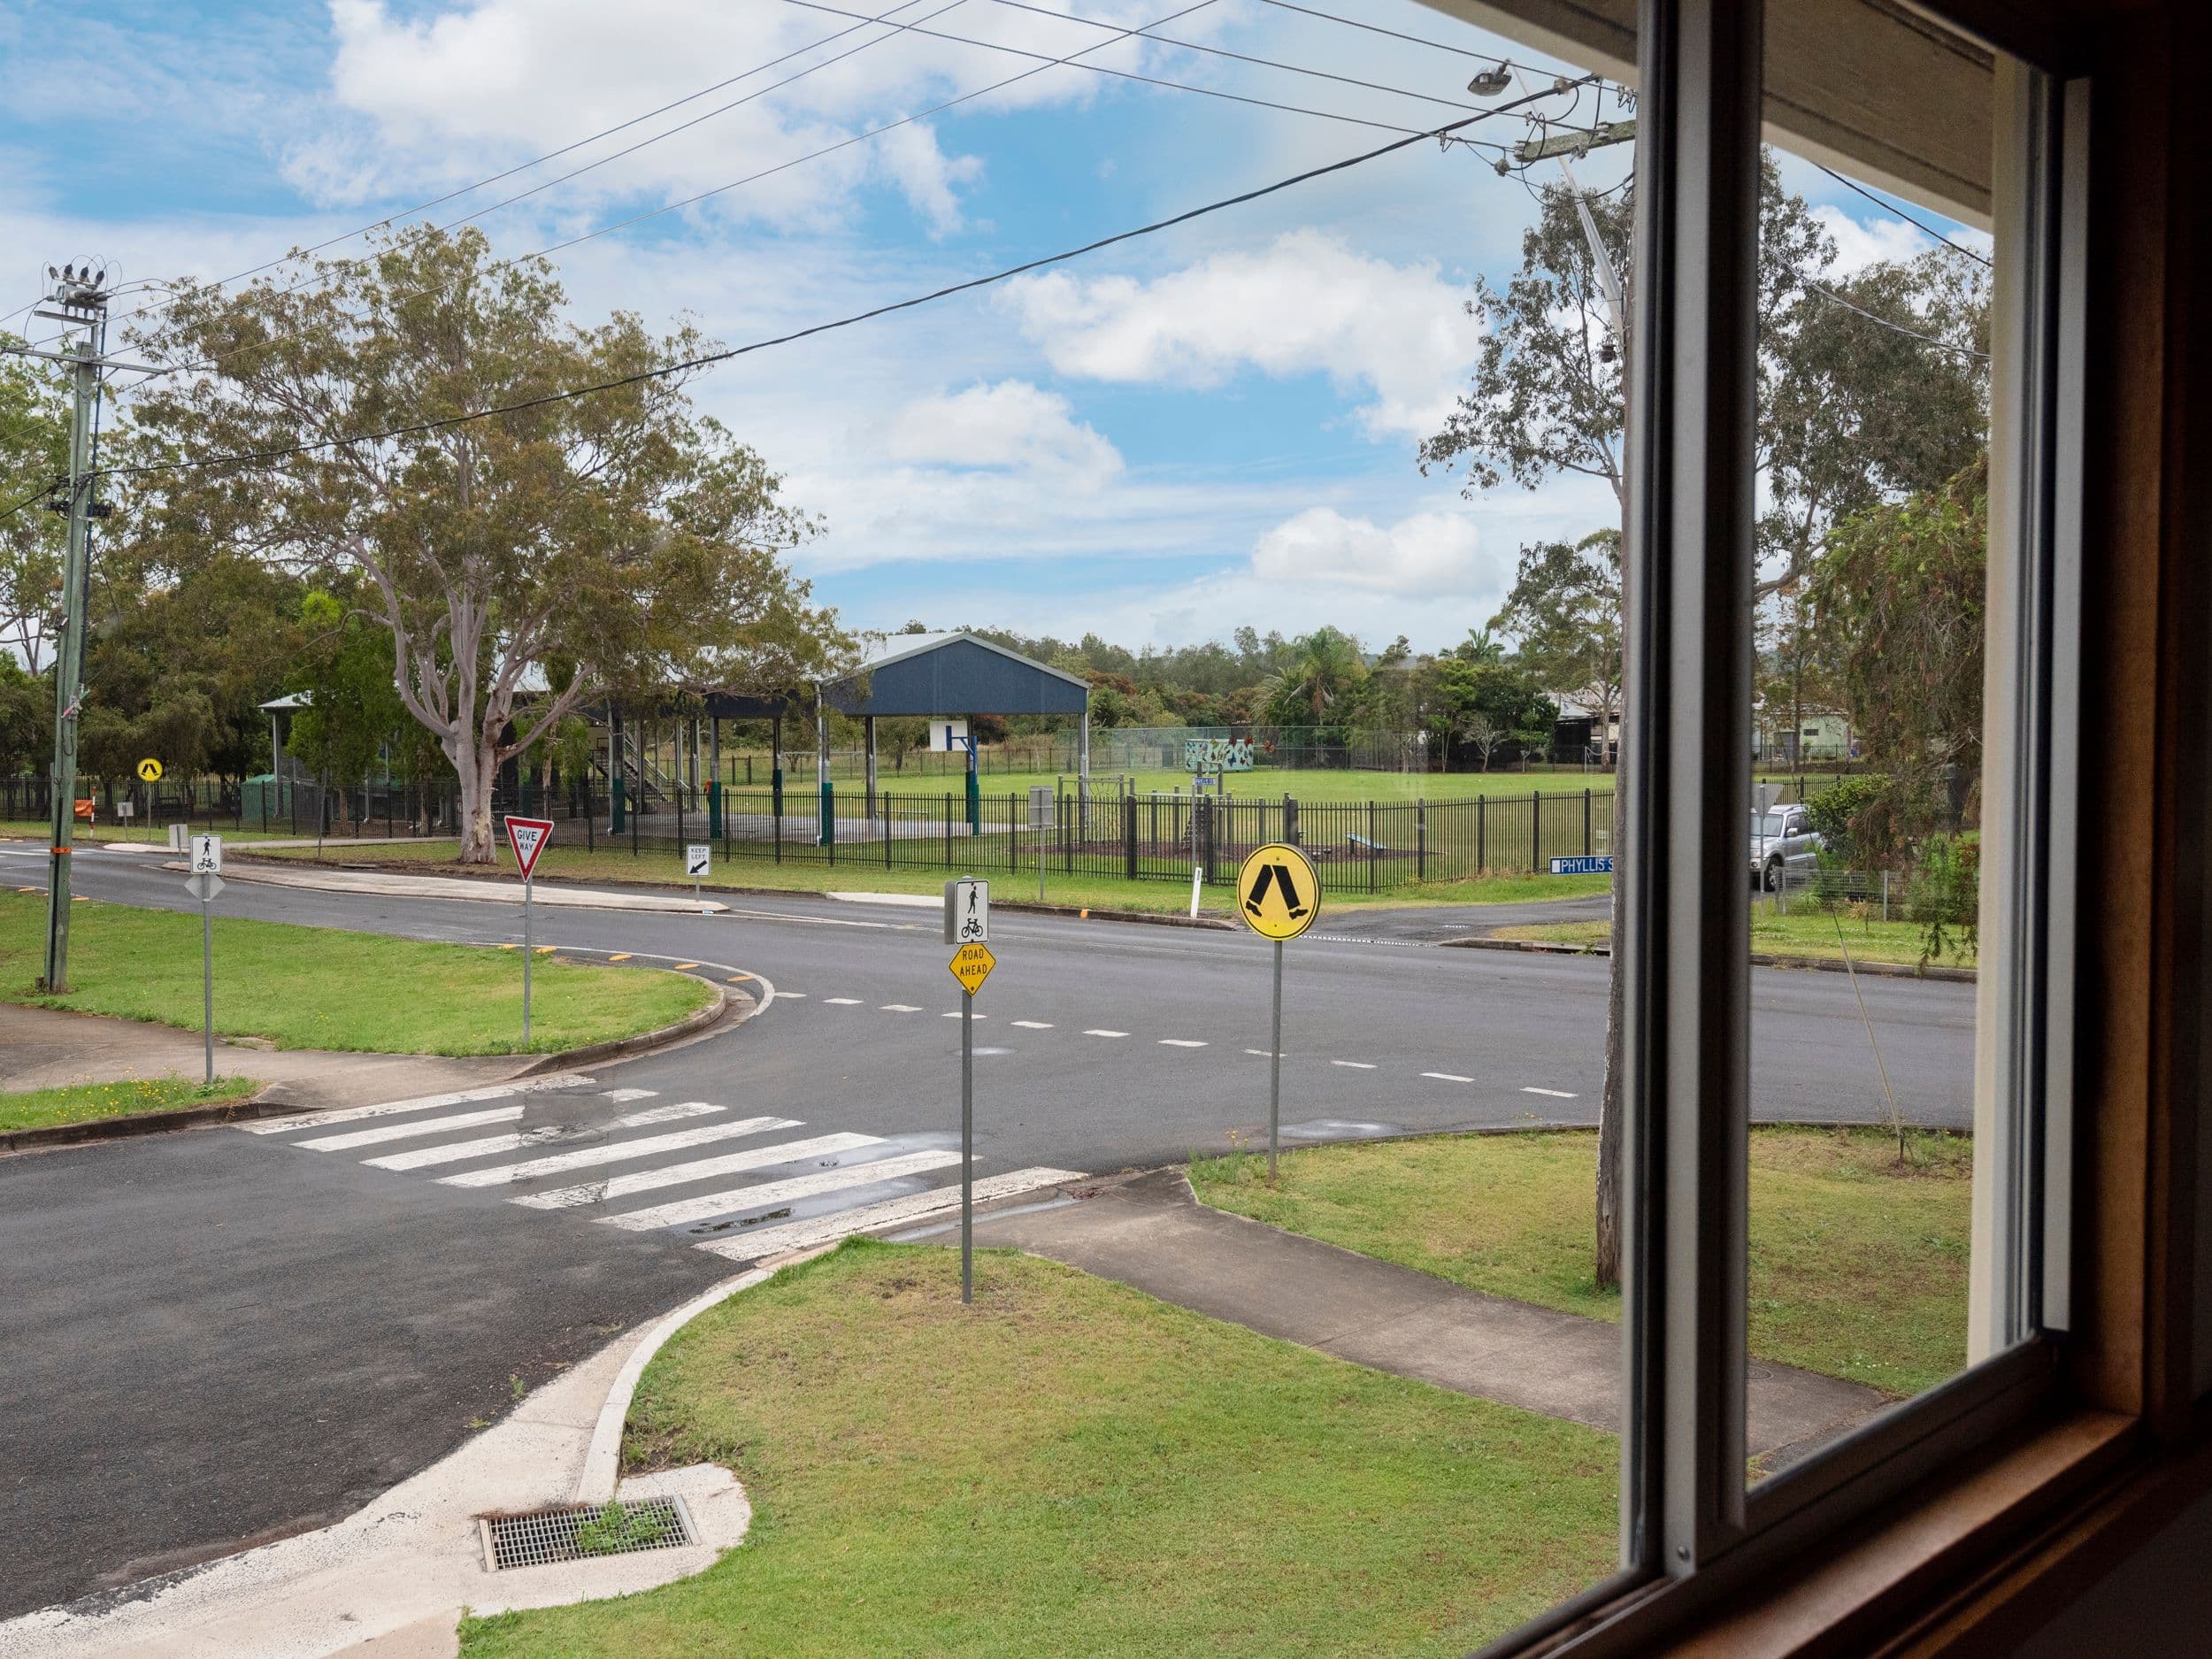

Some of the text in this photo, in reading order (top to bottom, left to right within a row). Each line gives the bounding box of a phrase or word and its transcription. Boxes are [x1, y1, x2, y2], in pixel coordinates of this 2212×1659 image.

[517, 829, 537, 841] GIVE
[519, 841, 534, 851] WAY
[1561, 858, 1605, 872] PHYLLIS
[962, 949, 984, 961] ROAD
[959, 964, 987, 977] AHEAD
